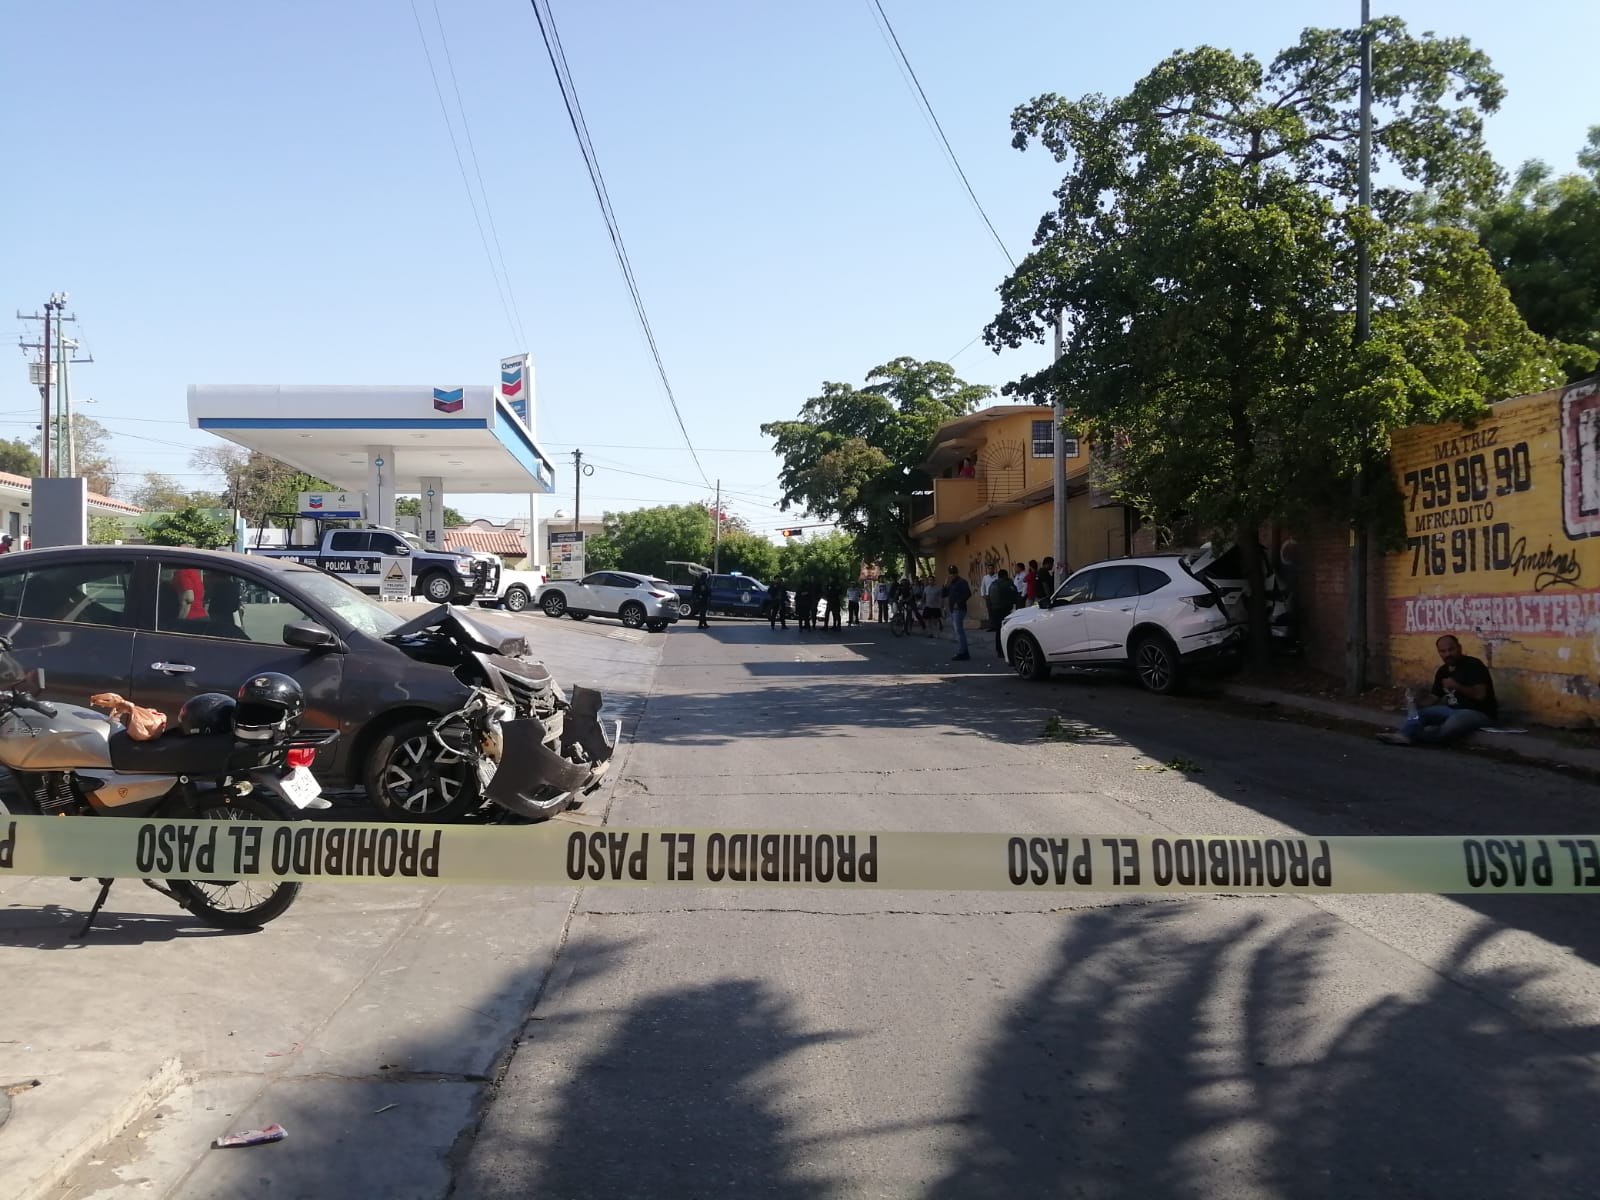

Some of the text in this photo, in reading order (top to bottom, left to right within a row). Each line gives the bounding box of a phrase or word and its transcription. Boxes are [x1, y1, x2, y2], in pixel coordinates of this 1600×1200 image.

[1434, 427, 1499, 461] MATRIZ
[338, 494, 346, 503] 4
[1404, 463, 1451, 512] 759
[1455, 453, 1489, 502] 90
[1494, 441, 1532, 496] 90
[1415, 502, 1494, 532] MERCADITO
[1407, 533, 1446, 577] 716
[1451, 528, 1477, 574] 91
[1482, 522, 1513, 571] 10
[136, 824, 442, 878] PROHIBIDO EL PASO
[566, 831, 878, 883] PROHIBIDO EL PASO
[1008, 837, 1332, 888] PROHIBIDO EL PASO
[1463, 839, 1600, 888] EL PASO
